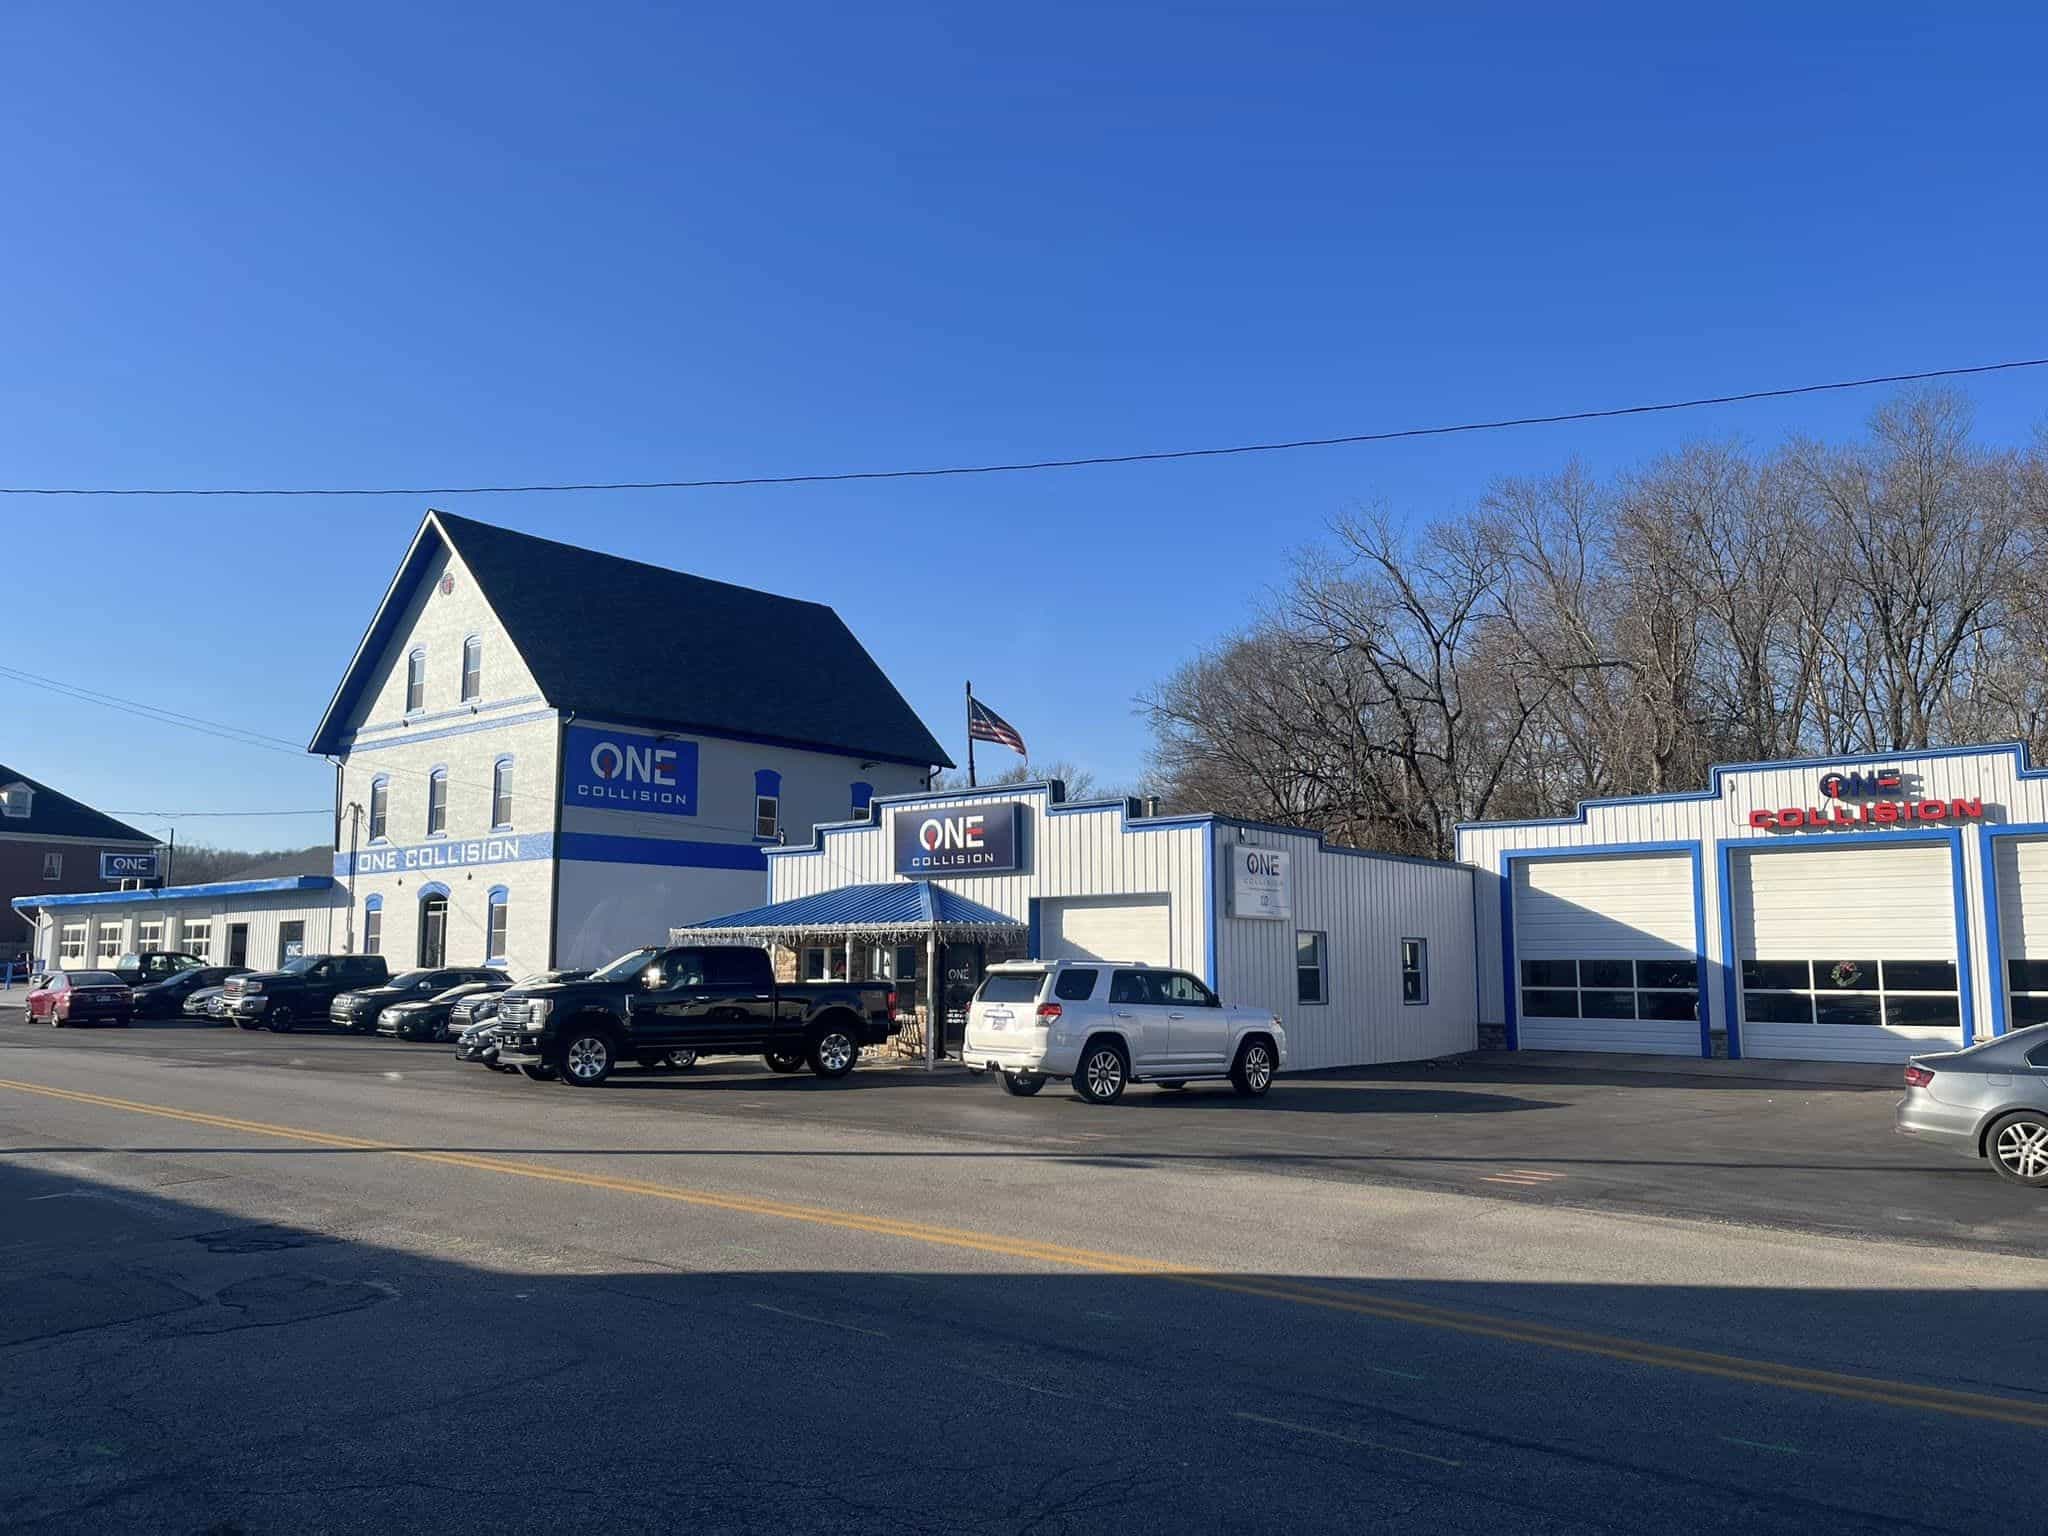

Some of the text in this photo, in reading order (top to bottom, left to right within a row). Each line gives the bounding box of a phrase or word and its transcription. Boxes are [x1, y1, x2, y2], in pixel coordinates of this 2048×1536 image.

[591, 742, 677, 787] ONE
[577, 784, 688, 805] COLLISION
[1819, 768, 1901, 799] ONE
[1749, 797, 1984, 828] COLLISION
[920, 815, 985, 852] ONE
[113, 857, 148, 871] ONE
[358, 839, 520, 872] ONE COLLISION
[912, 852, 994, 867] COLLISION
[1246, 852, 1281, 876] ONE
[948, 968, 969, 980] ONE
